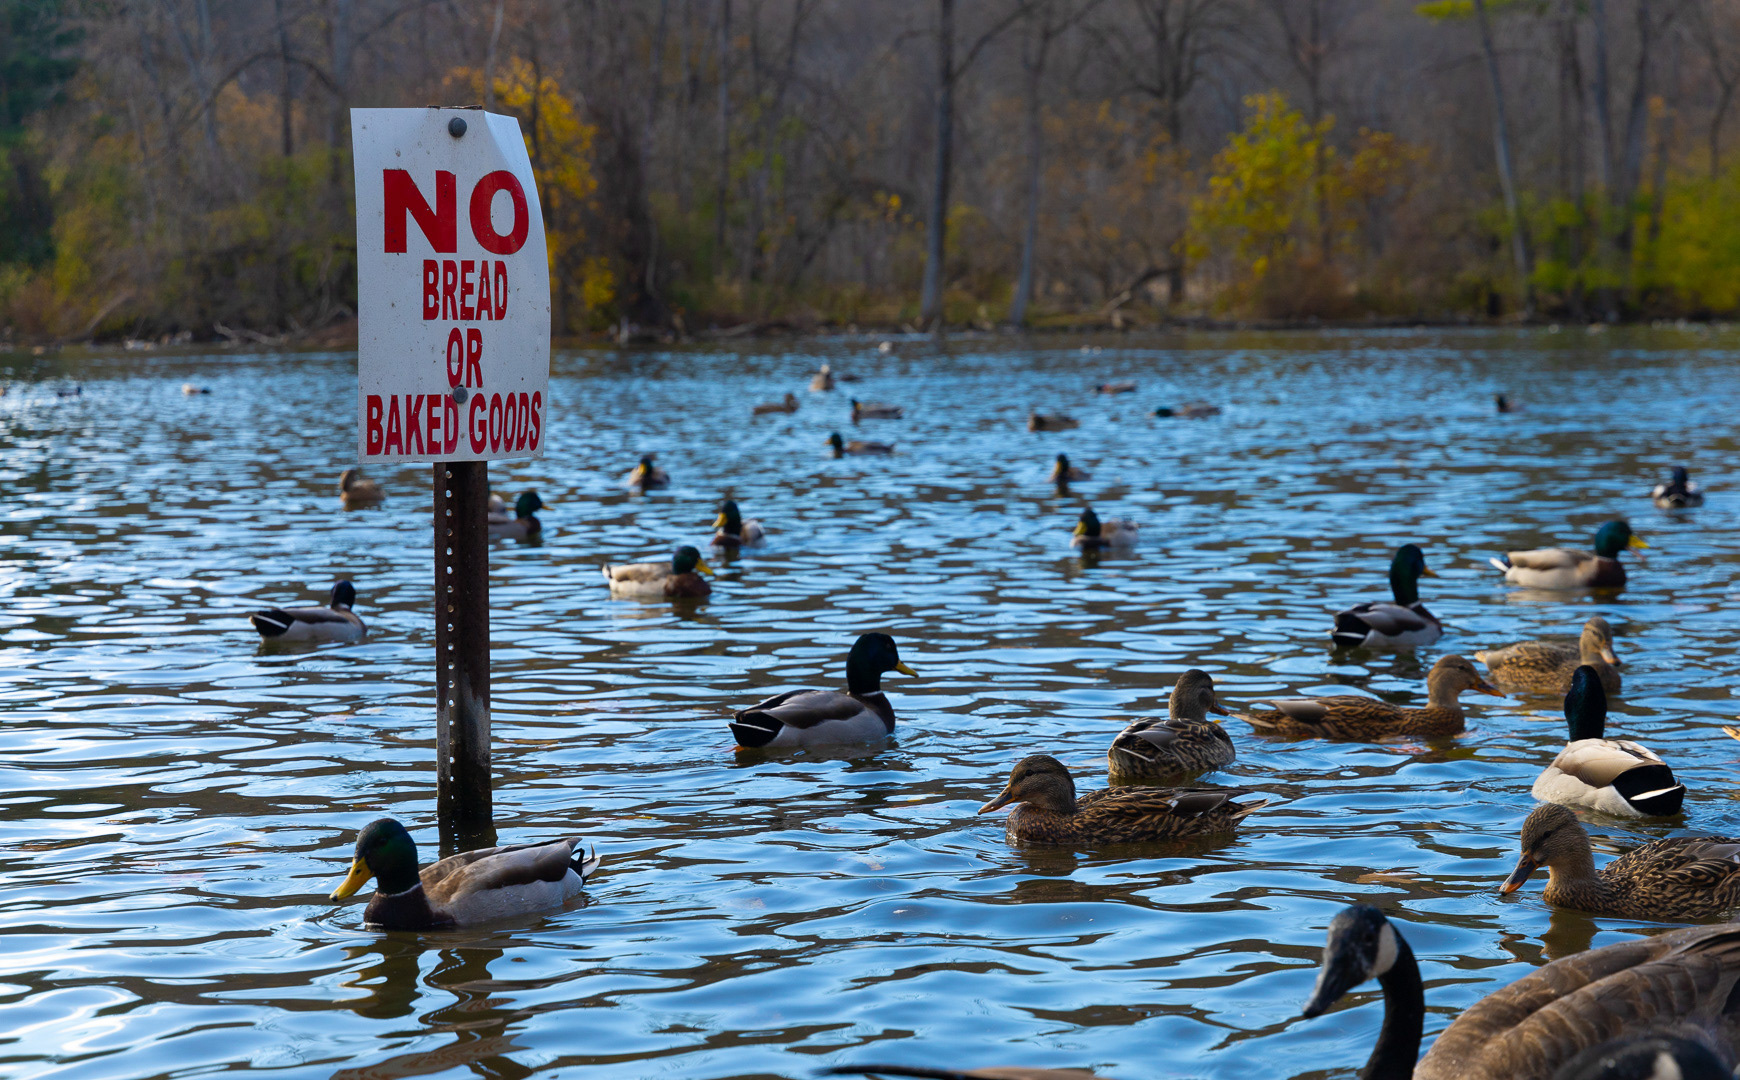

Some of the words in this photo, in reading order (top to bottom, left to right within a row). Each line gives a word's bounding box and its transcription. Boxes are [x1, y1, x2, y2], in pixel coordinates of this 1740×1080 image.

[383, 169, 529, 255] NO
[423, 259, 508, 320] BREAD
[446, 327, 483, 388] OR
[366, 394, 459, 455] BAKED
[469, 391, 542, 454] GOODS
